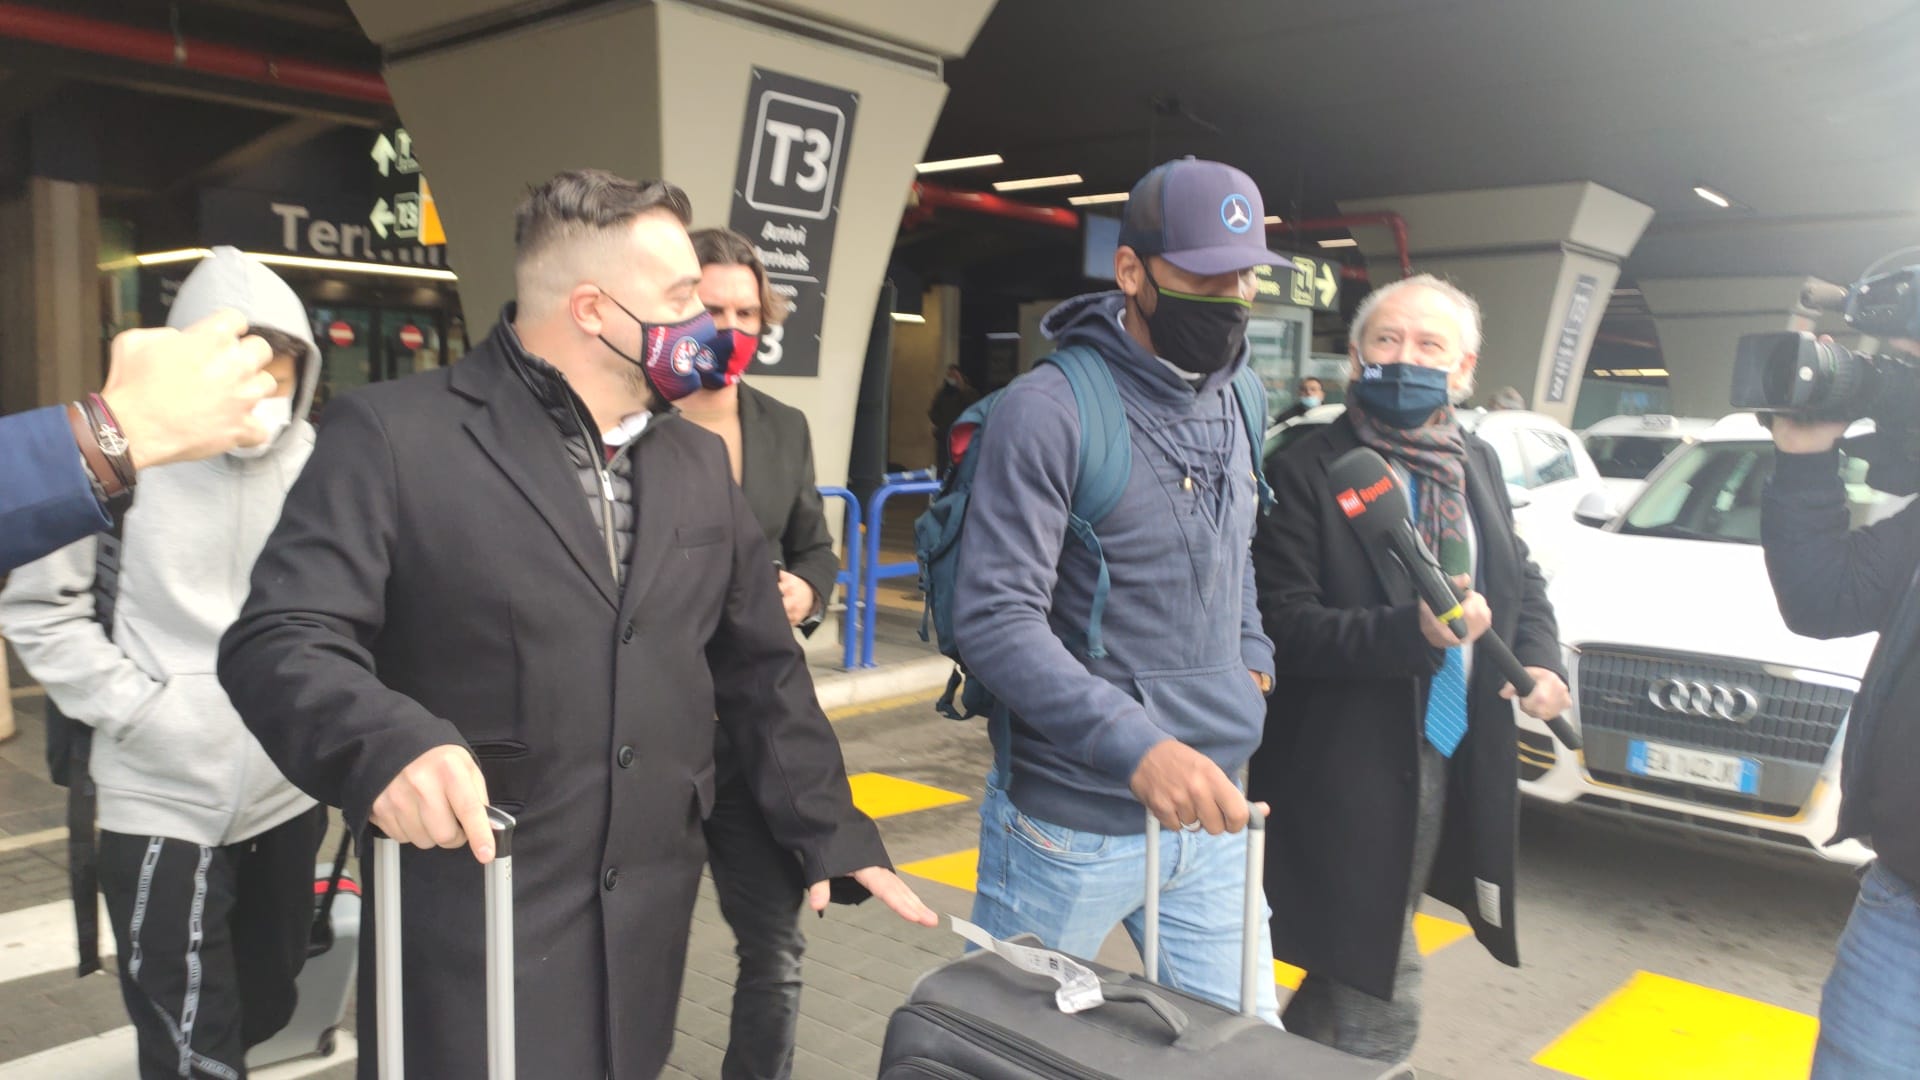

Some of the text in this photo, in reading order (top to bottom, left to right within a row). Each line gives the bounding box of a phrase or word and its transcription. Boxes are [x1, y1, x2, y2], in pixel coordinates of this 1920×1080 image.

[765, 118, 832, 193] T3
[761, 220, 807, 246] Arrivi
[756, 322, 784, 366] 3
